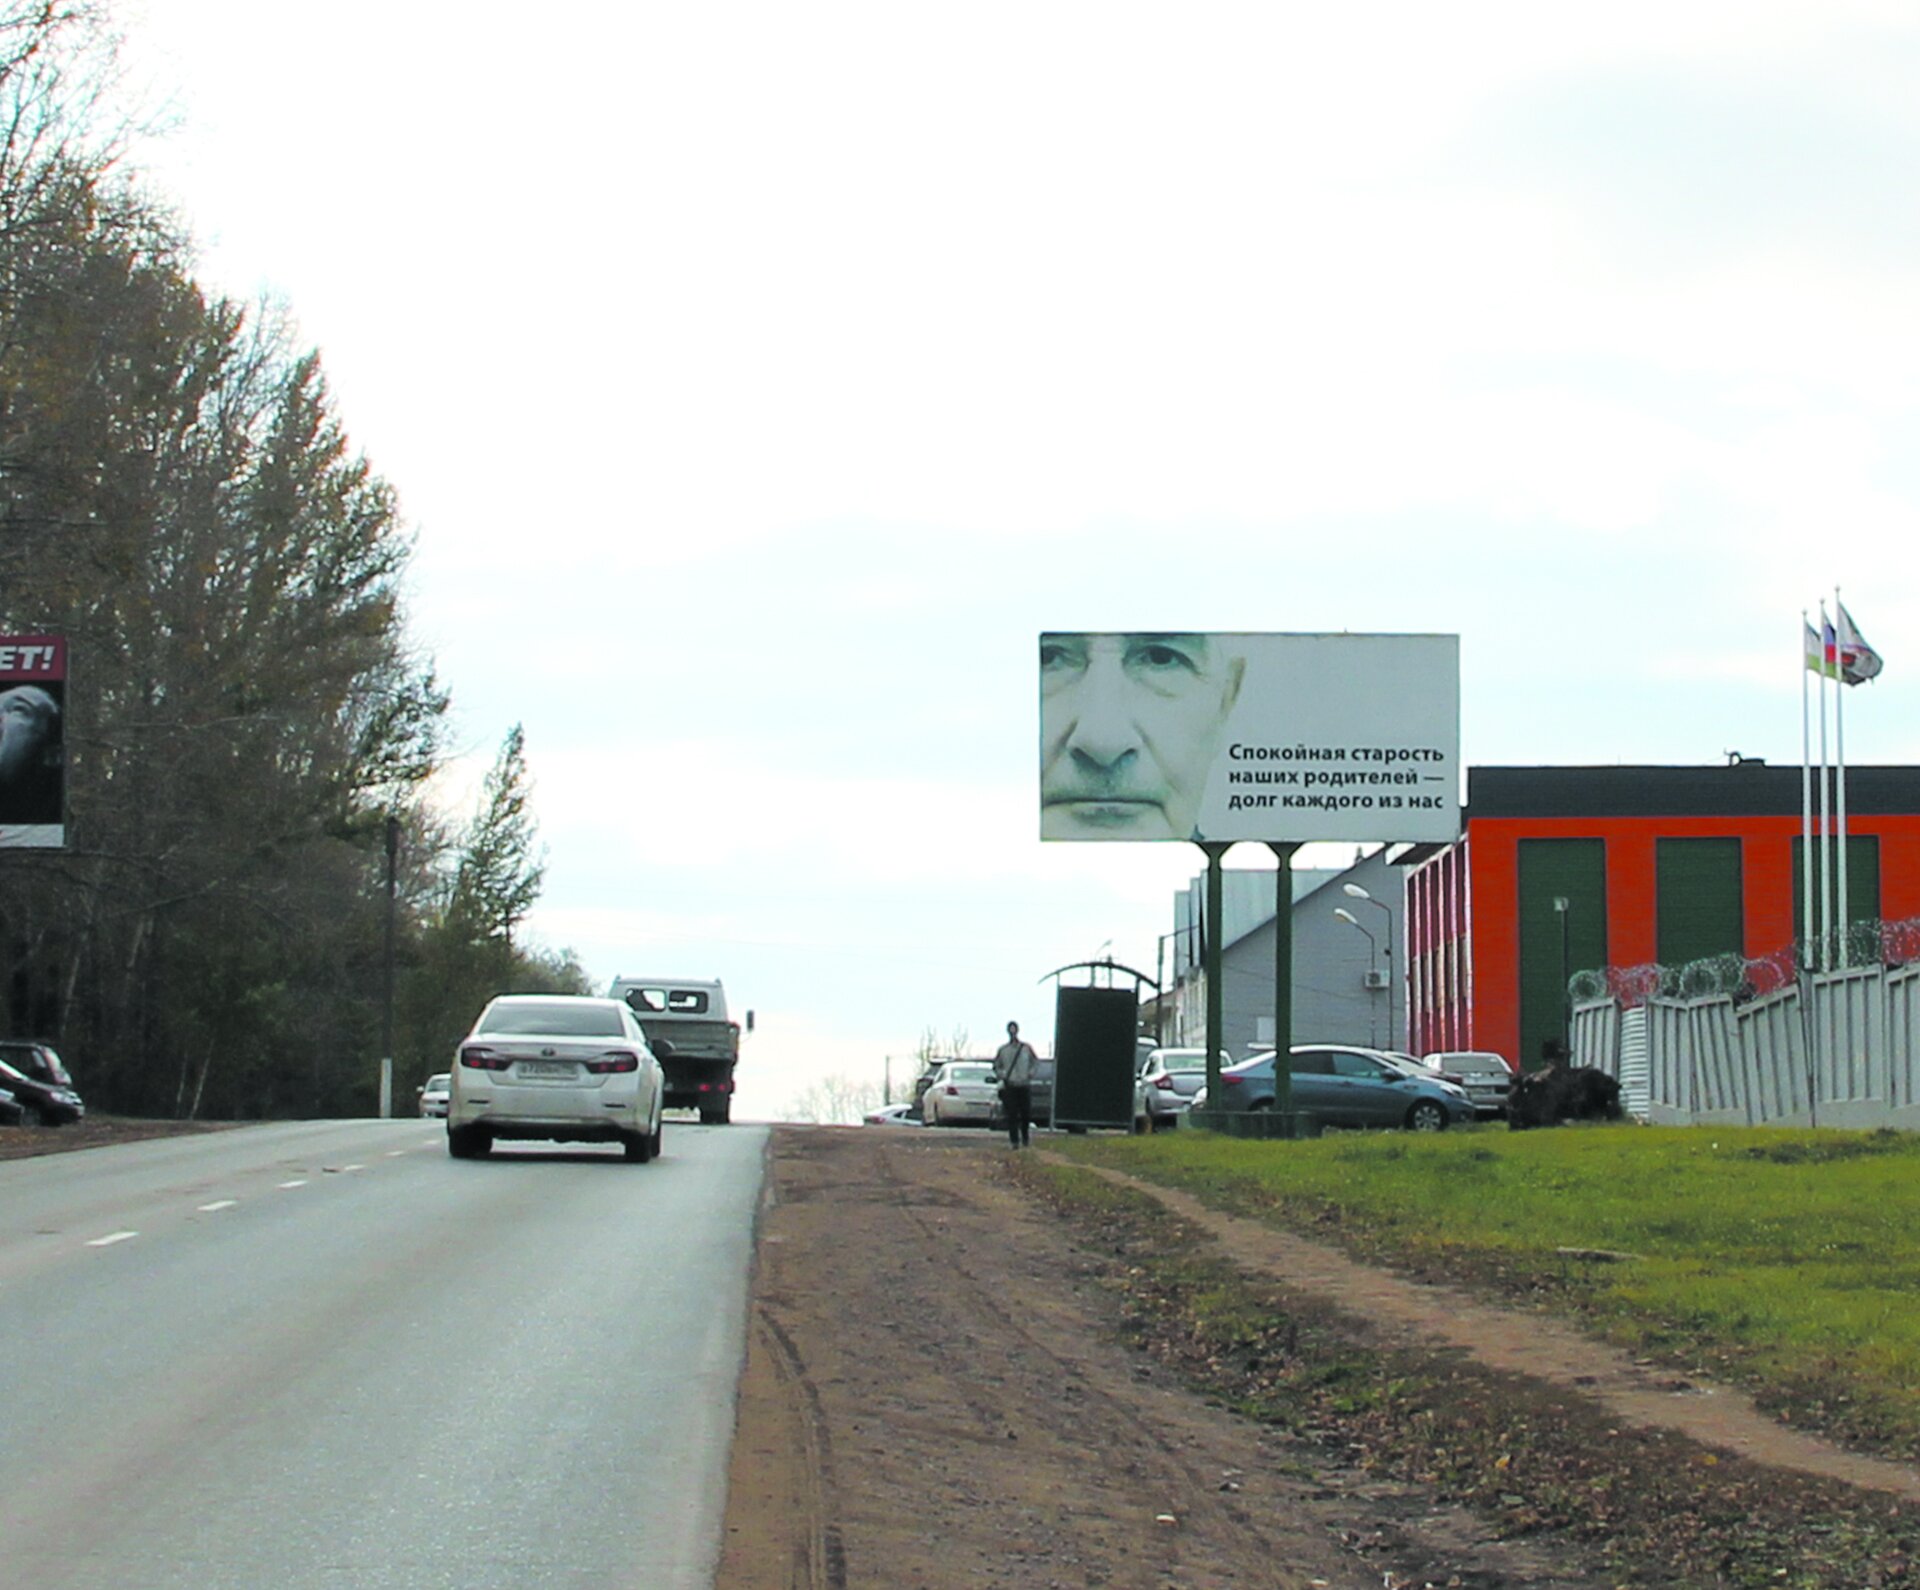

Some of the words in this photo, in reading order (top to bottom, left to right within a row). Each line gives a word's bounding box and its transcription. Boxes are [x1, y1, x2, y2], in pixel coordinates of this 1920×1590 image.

[1229, 743, 1346, 760] Спокойная
[1351, 747, 1444, 765] старость
[1229, 770, 1298, 784] наших
[1304, 768, 1418, 788] родителей
[1228, 794, 1277, 810] долг
[1283, 794, 1373, 811] каждого
[1379, 795, 1403, 808] из
[1408, 795, 1443, 809] нас
